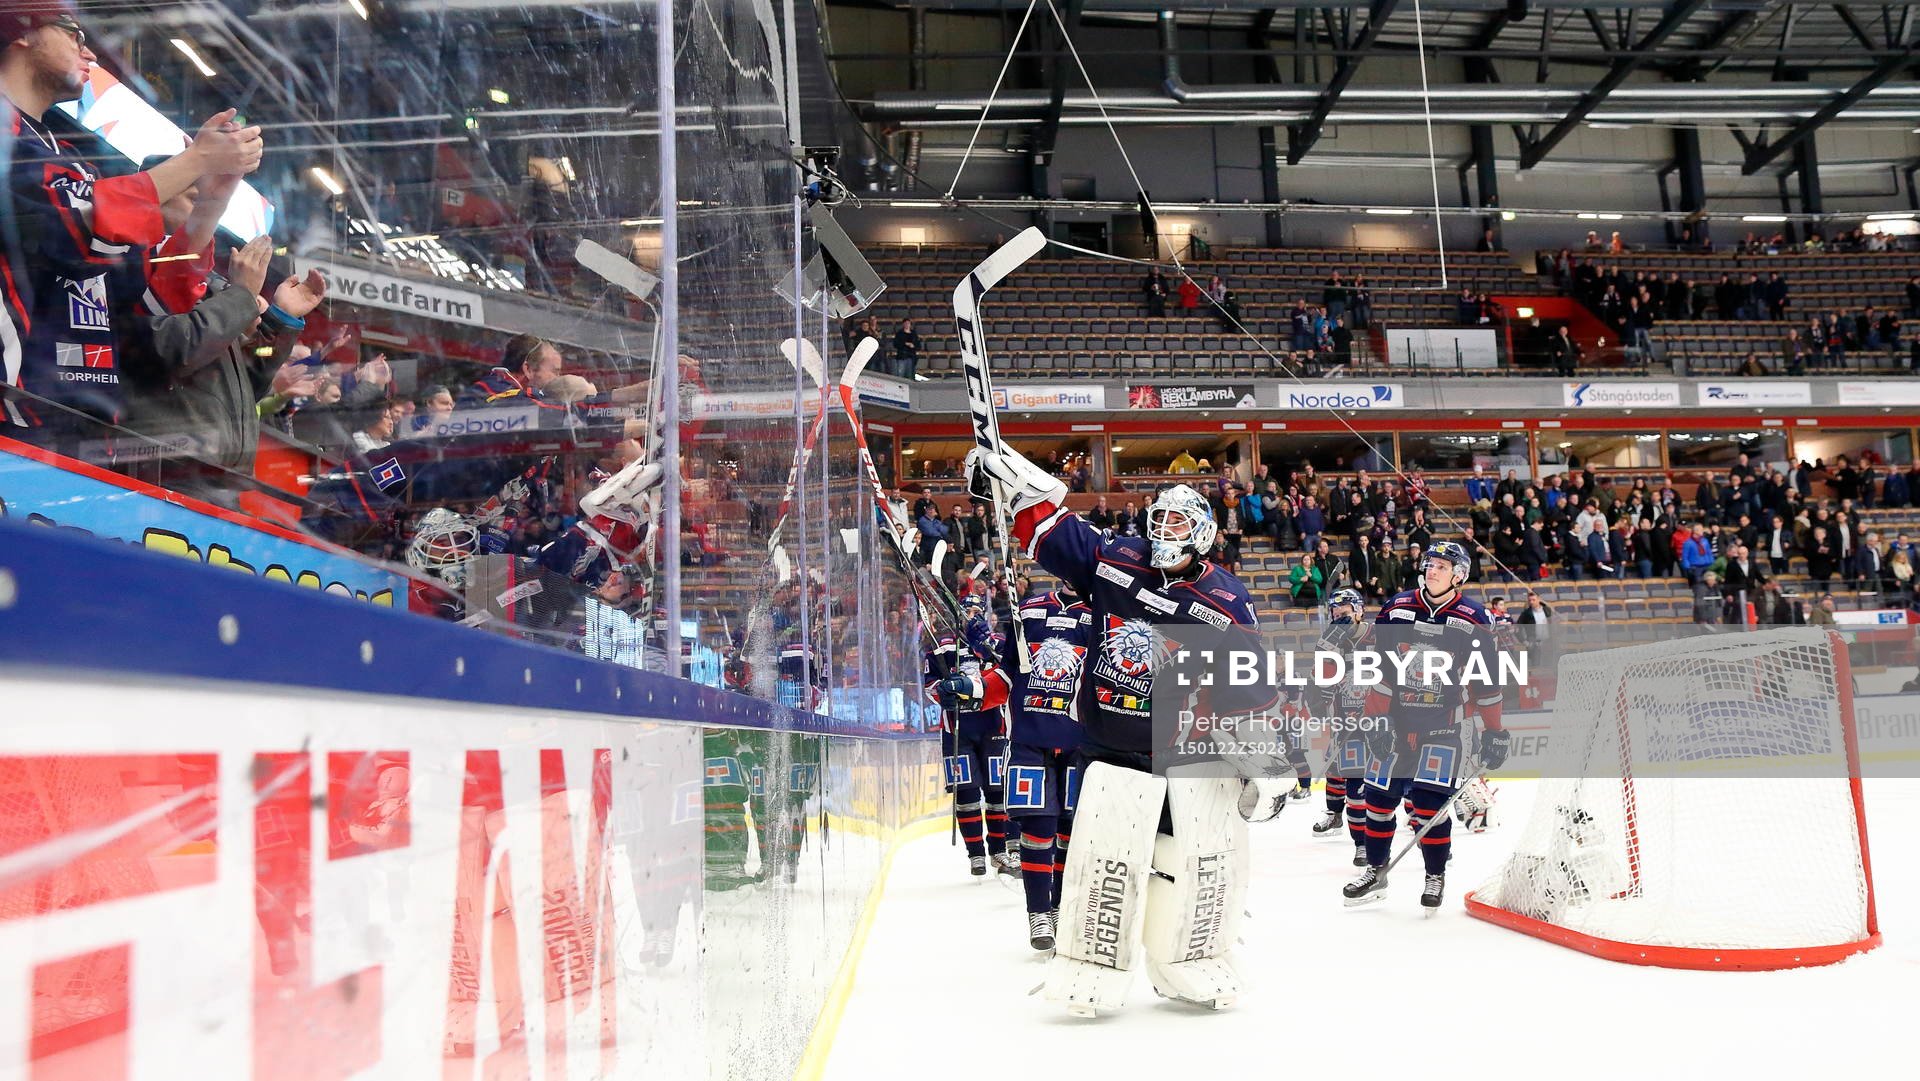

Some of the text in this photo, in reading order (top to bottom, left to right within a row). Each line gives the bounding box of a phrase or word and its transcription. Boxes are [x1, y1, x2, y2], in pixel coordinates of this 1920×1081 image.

[957, 316, 994, 451] CCM
[1161, 386, 1236, 404] REKLAMBYRÅ
[1290, 392, 1370, 408] Nordea
[1588, 388, 1674, 406] Stångåstaden
[1012, 393, 1092, 408] GigantPrint
[1191, 606, 1228, 630] LEGENDS
[1857, 707, 1920, 740] Bran
[1083, 887, 1100, 940] NEW YORK
[1094, 859, 1129, 969] LEGENDS
[1185, 855, 1218, 963] LEGENDS
[1211, 883, 1227, 935] NEW YORK
